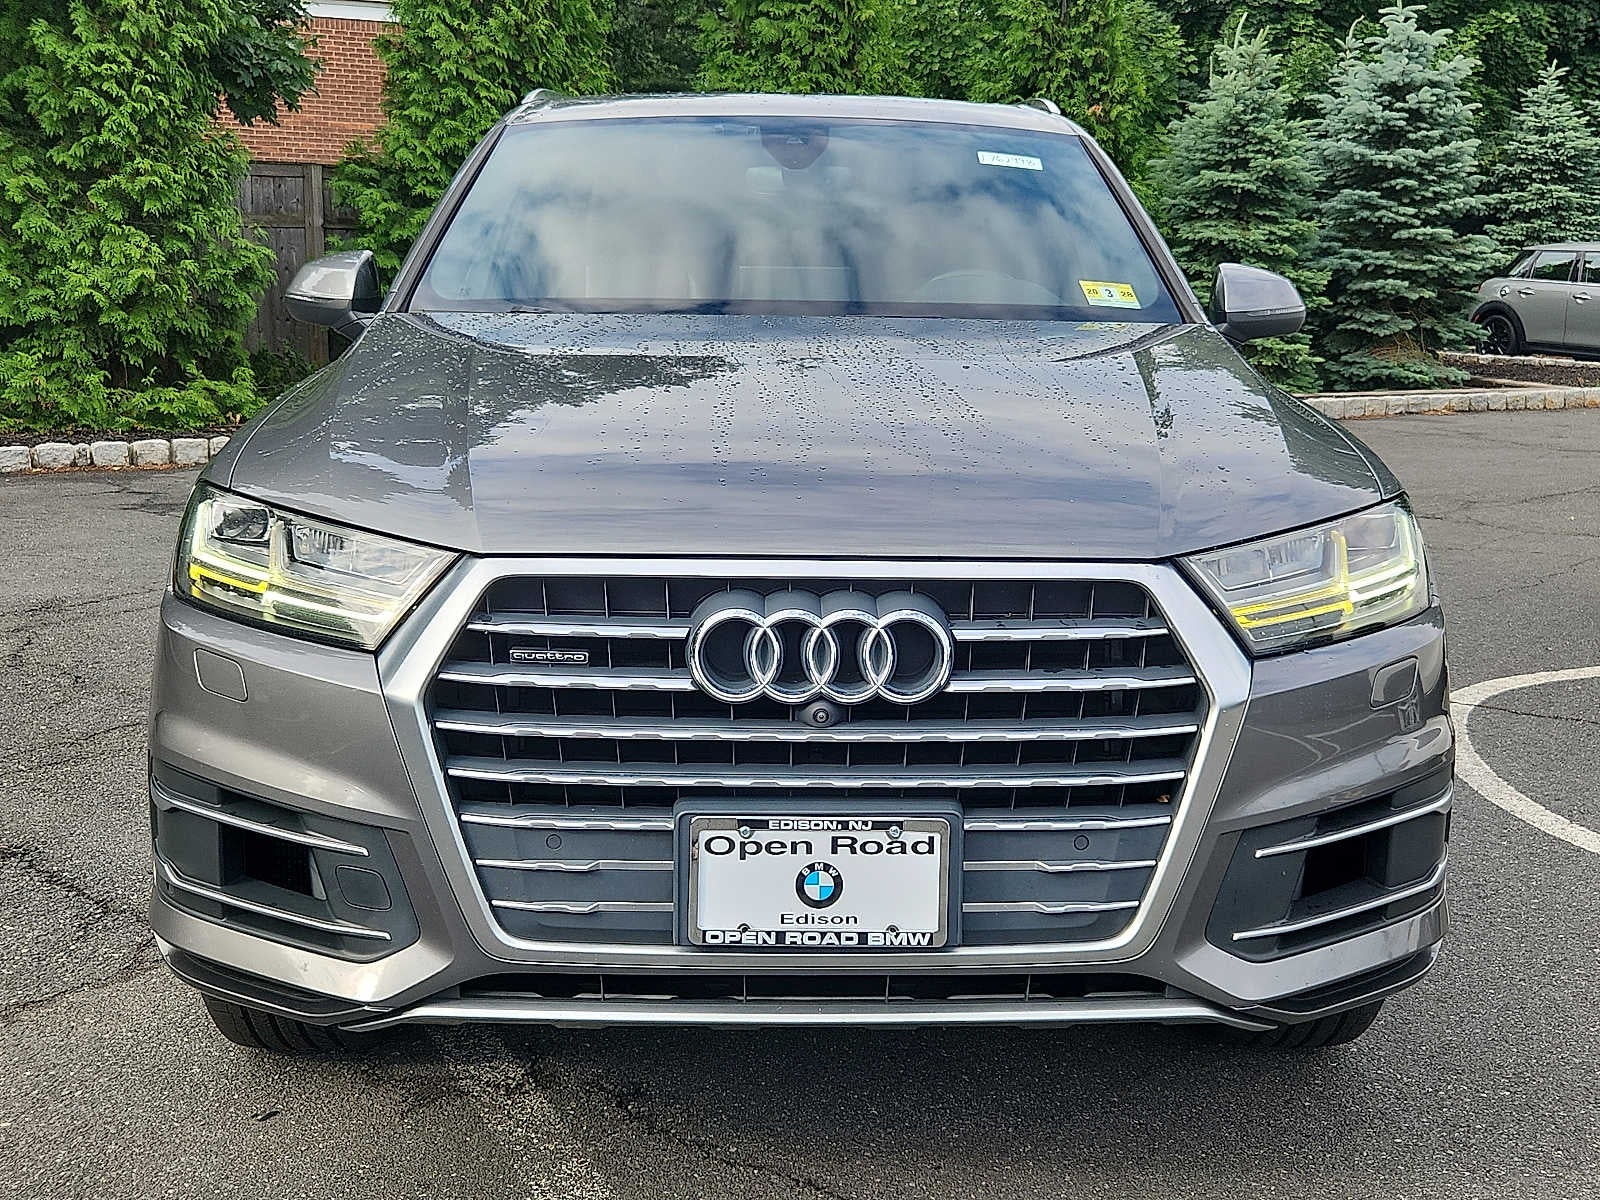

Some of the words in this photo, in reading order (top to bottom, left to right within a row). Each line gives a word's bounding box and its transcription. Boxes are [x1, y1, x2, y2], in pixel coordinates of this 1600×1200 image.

[1104, 288, 1114, 298] 3
[512, 652, 585, 661] quattro
[848, 821, 873, 830] NJ
[704, 835, 813, 860] Open
[830, 835, 935, 856] Road
[801, 862, 839, 877] BMW
[780, 913, 858, 925] Edison
[705, 931, 776, 945] OPEN
[784, 932, 859, 945] ROAD
[867, 932, 931, 945] BMW
